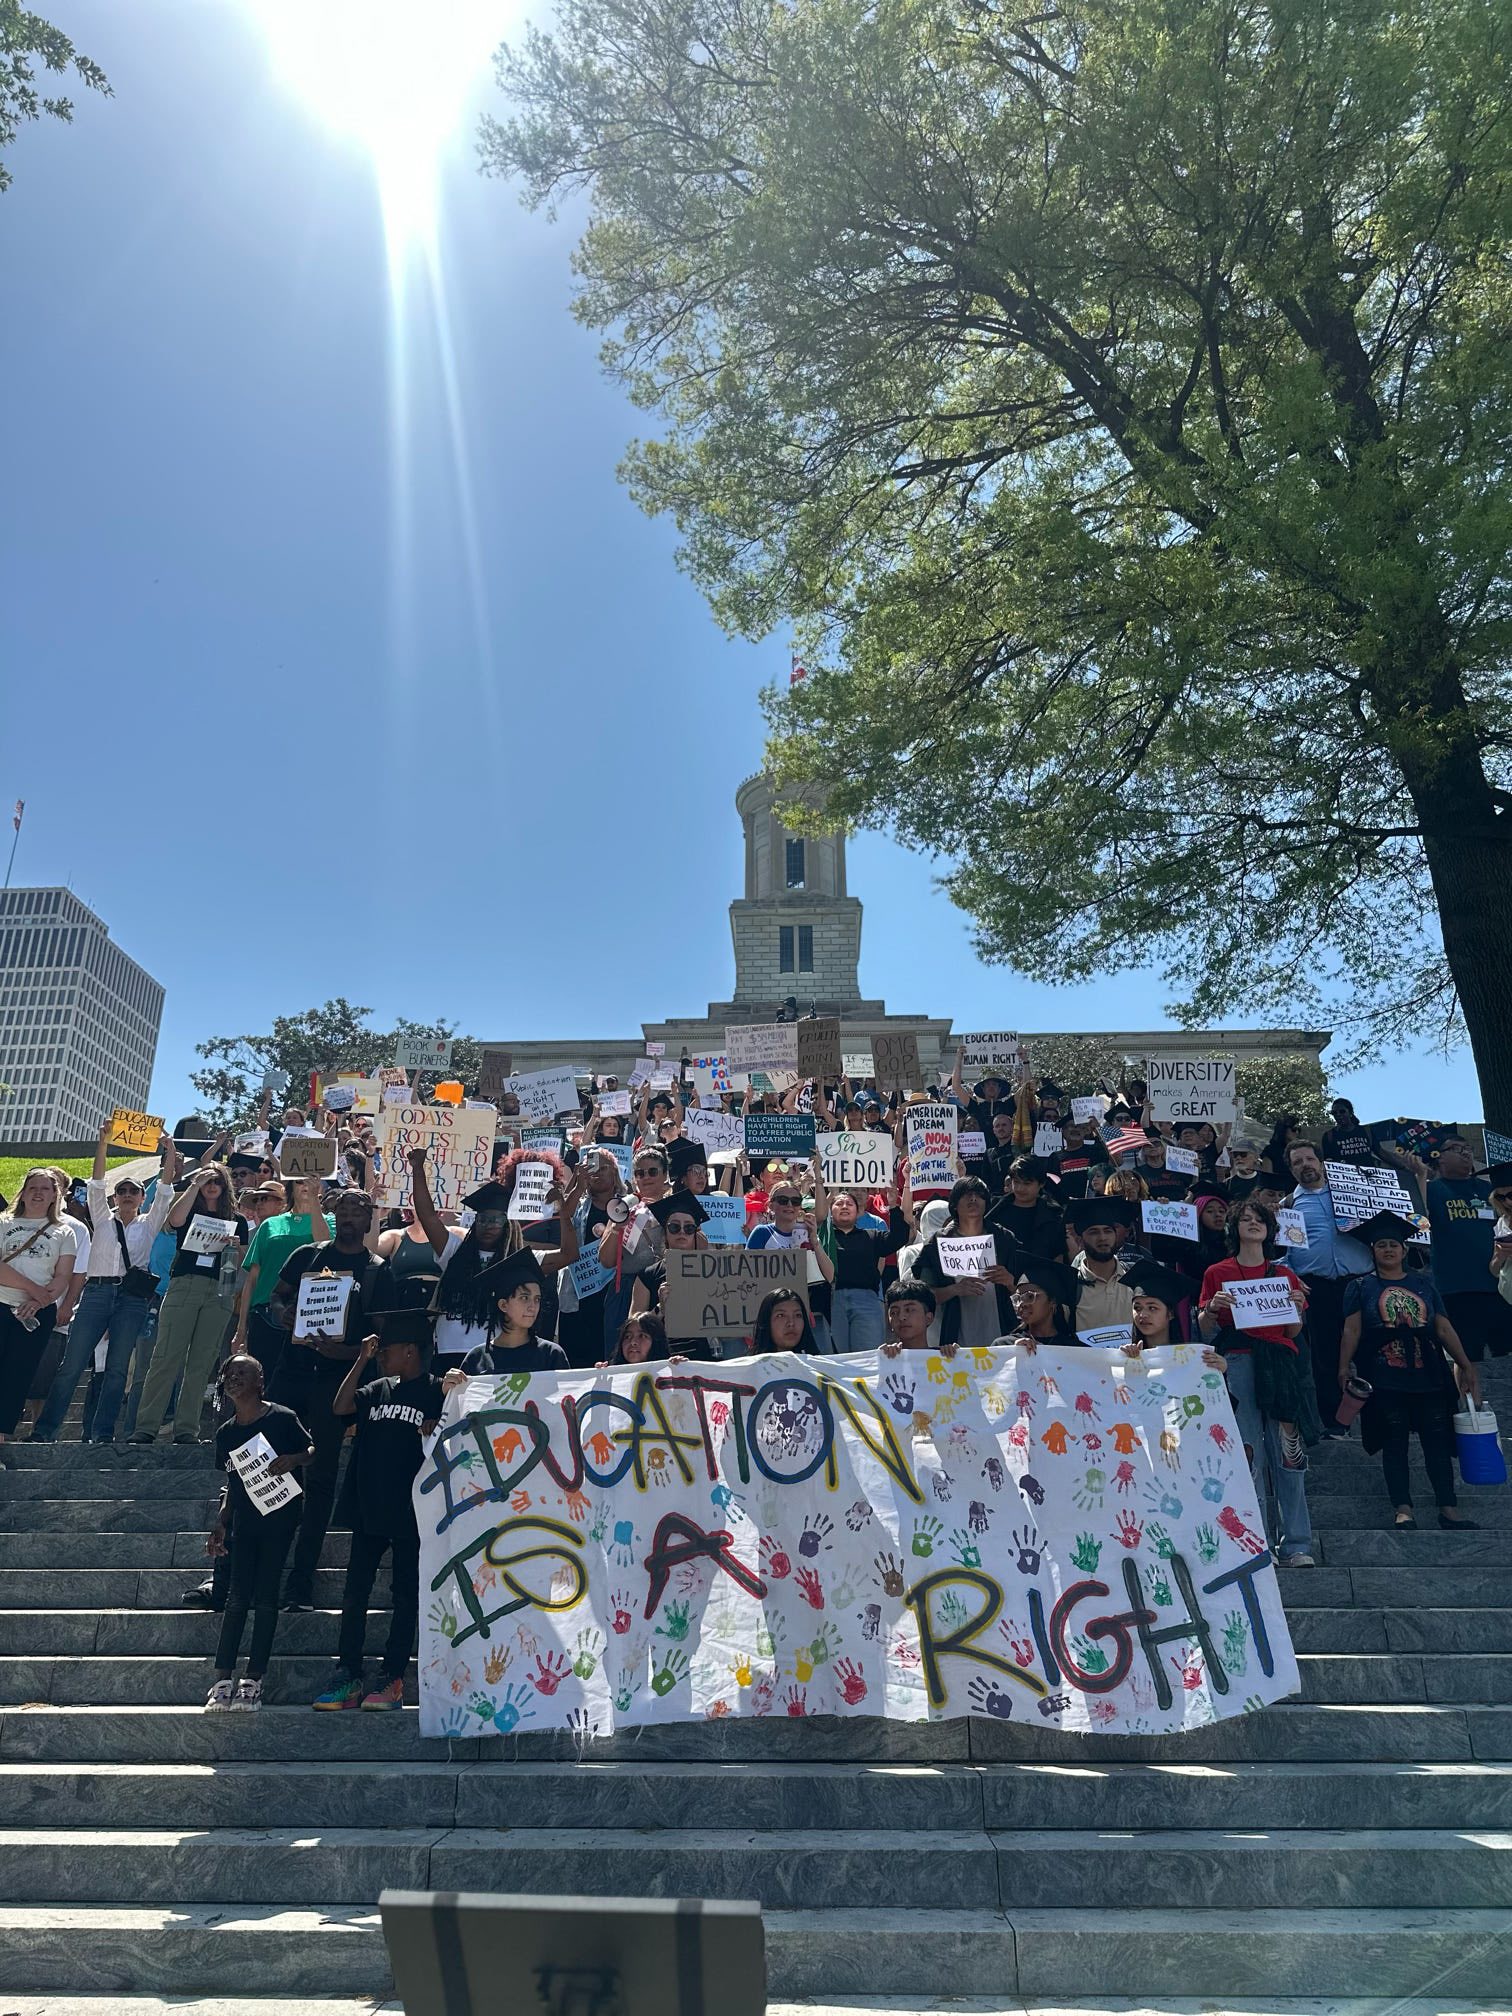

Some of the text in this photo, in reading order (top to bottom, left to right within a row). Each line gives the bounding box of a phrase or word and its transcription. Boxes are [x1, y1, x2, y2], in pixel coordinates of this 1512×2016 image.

[965, 1033, 1017, 1044] EDUCATION
[403, 1041, 430, 1051] BOOK
[875, 1036, 915, 1058] OMG
[409, 1053, 448, 1066] BURNERS
[877, 1055, 914, 1073] GOP
[963, 1053, 1016, 1065] HUMAN RIGHT
[1150, 1062, 1233, 1081] DIVERSITY
[713, 1080, 733, 1091] ALL
[1153, 1084, 1232, 1098] makes America
[524, 1093, 556, 1108] RIGHT
[907, 1107, 953, 1120] AMERICAN
[1170, 1102, 1217, 1116] GREAT
[113, 1109, 164, 1128] EDUCATION
[391, 1108, 454, 1127] TODAYS
[687, 1111, 714, 1127] Vote
[128, 1124, 149, 1134] FOR
[913, 1120, 945, 1131] DREAM
[113, 1132, 152, 1147] ALL
[389, 1127, 488, 1151] PROTEST IS
[925, 1133, 952, 1146] NOW
[1487, 1133, 1498, 1142] ALL
[284, 1141, 330, 1149] EDUCATION
[820, 1133, 876, 1156] Sin
[924, 1144, 951, 1158] Only
[1342, 1142, 1367, 1150] RADICAL
[1488, 1140, 1508, 1150] HAVE
[382, 1142, 488, 1166] BROGHT TO
[1340, 1147, 1371, 1156] EMPATHY
[289, 1158, 325, 1172] ALL
[424, 1160, 446, 1178] BY
[451, 1164, 484, 1182] THE
[916, 1160, 946, 1172] FOR THE
[1326, 1164, 1358, 1174] Those
[534, 1170, 549, 1178] WANT
[821, 1160, 886, 1184] MIEDO!
[519, 1181, 544, 1190] CONTROL.
[911, 1174, 926, 1186] RICH
[932, 1173, 954, 1182] WHITE
[1344, 1173, 1366, 1184] hurt
[1369, 1178, 1398, 1187] SOME
[457, 1180, 467, 1196] E
[1330, 1182, 1374, 1195] children
[528, 1194, 545, 1202] WANT
[1333, 1194, 1368, 1206] willing
[1387, 1200, 1412, 1211] hurt
[518, 1204, 544, 1213] JUSTICE.
[708, 1210, 742, 1219] ELCOME
[1335, 1206, 1355, 1215] ALL
[1146, 1218, 1194, 1231] EDUCATION
[1150, 1224, 1188, 1236] FOR ALL
[940, 1241, 992, 1252] EDUCATION
[574, 1262, 592, 1272] ARE
[682, 1254, 796, 1279] EDUCATION
[944, 1256, 990, 1271] FOR ALL
[576, 1269, 600, 1282] HERE
[310, 1286, 326, 1294] Black
[737, 1280, 760, 1301] for
[1228, 1284, 1290, 1296] EDUCATION
[306, 1295, 338, 1305] Brown Kids
[1256, 1296, 1292, 1312] RIGHT
[300, 1304, 342, 1316] Deserve School
[702, 1304, 756, 1327] ALL
[306, 1318, 334, 1328] Choice Too
[368, 1404, 424, 1426] MEMPHIS
[259, 1452, 270, 1463] TO
[420, 1371, 928, 1536] EDUCATION
[275, 1475, 286, 1485] IN
[430, 1510, 1278, 1711] IS A RIGHT
